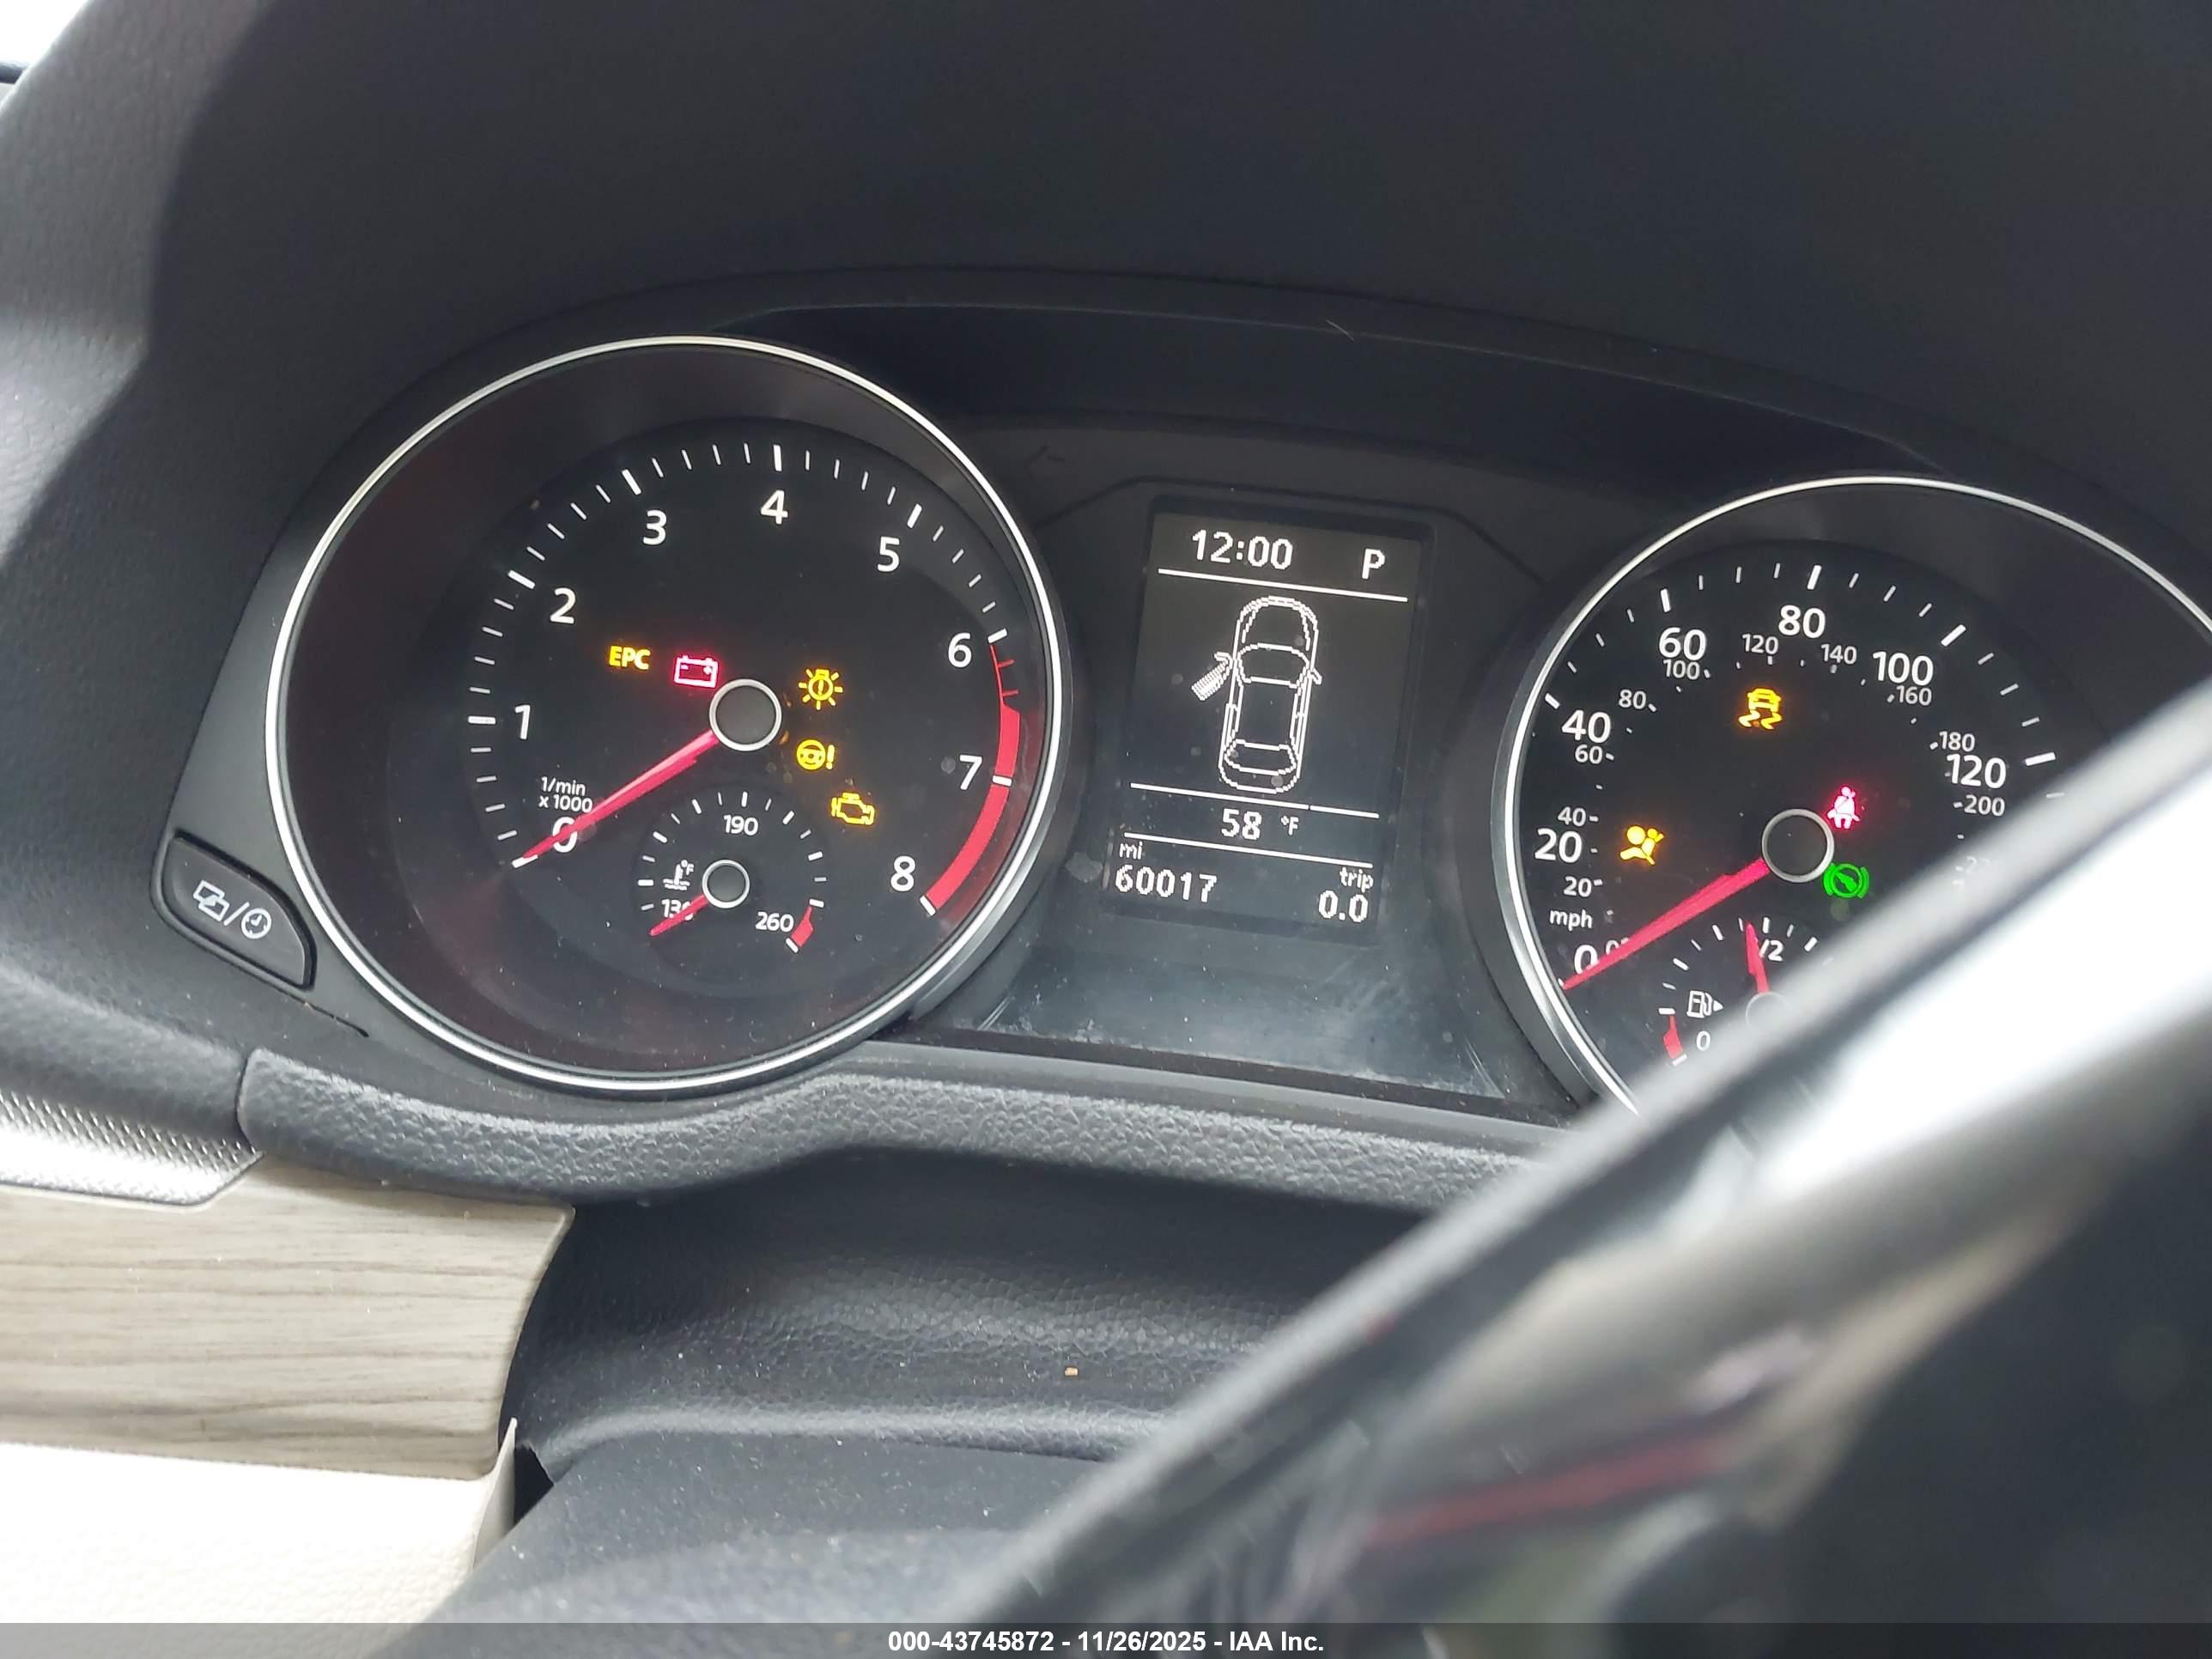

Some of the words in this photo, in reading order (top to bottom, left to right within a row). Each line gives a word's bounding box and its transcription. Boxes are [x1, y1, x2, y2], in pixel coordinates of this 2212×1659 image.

[760, 489, 788, 525] 4
[642, 509, 667, 545] 3
[877, 536, 900, 572] 5
[1192, 529, 1293, 569] 12:00
[1361, 548, 1386, 580] P
[550, 587, 576, 624] 2
[1778, 605, 1826, 638] 80
[608, 645, 651, 670] EPC
[948, 632, 972, 668] 6
[1658, 627, 1707, 660] 60
[1741, 634, 1779, 654] 120
[1820, 643, 1857, 665] 140
[1663, 659, 1701, 680] 100
[1872, 651, 1934, 686] 100
[1618, 689, 1647, 709] 80
[1896, 685, 1932, 706] 160
[514, 704, 531, 740] 1
[1561, 710, 1611, 744] 40
[1574, 744, 1603, 764] 60
[1939, 732, 1975, 751] 180
[959, 754, 982, 791] 7
[1948, 754, 2007, 789] 120
[539, 776, 586, 798] 1/min
[538, 796, 550, 808] x
[553, 796, 592, 812] 1000
[1557, 806, 1587, 827] 40
[1964, 794, 2005, 817] 200
[551, 816, 578, 853] 0
[723, 814, 759, 836] 190
[1221, 808, 1262, 841] 58
[1119, 841, 1143, 860] mi
[1534, 828, 1583, 863] 20
[890, 855, 916, 892] 8
[1115, 864, 1218, 902] 60017
[1339, 866, 1374, 893] trip
[1563, 876, 1592, 896] 20
[1318, 890, 1369, 923] 0.0
[1549, 908, 1593, 932] mph
[755, 911, 794, 933] 260
[1574, 945, 1600, 975] 0
[1759, 938, 1784, 962] /2
[1696, 1030, 1711, 1052] 0
